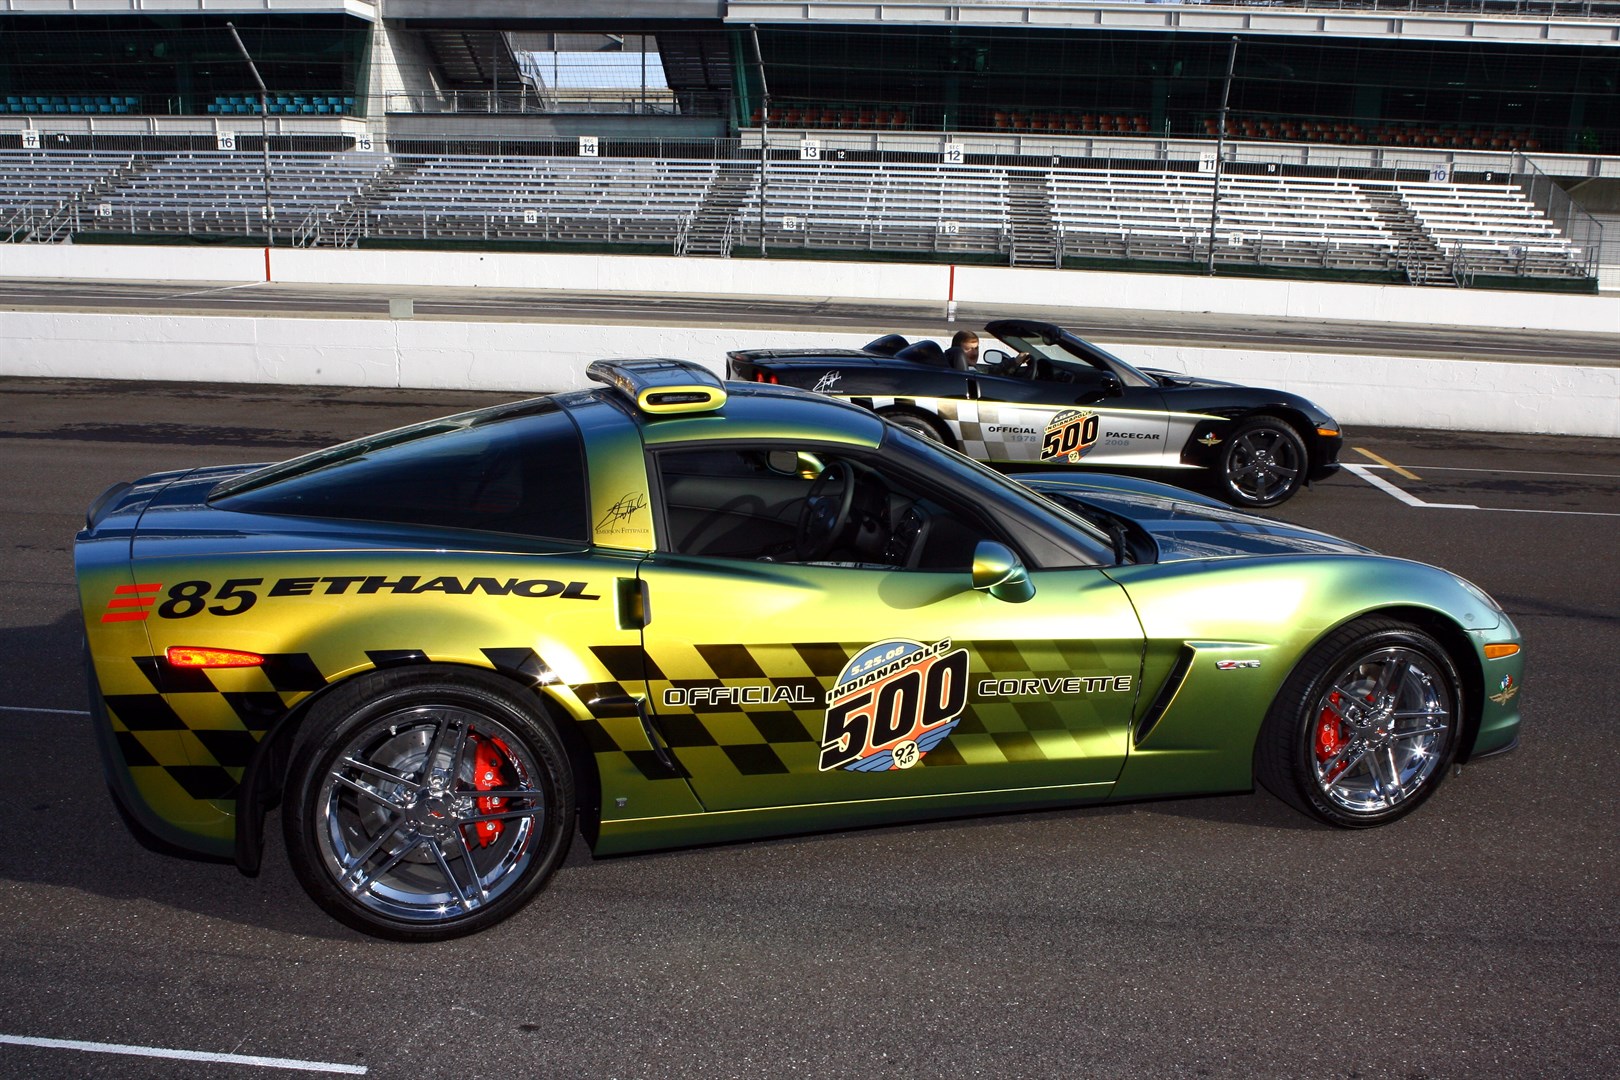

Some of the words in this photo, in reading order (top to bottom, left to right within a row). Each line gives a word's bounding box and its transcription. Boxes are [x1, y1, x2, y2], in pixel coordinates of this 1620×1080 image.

[25, 136, 36, 146] 17
[220, 137, 233, 148] 16
[359, 139, 371, 150] 15
[583, 143, 595, 154] 14
[804, 146, 817, 158] 13
[837, 151, 845, 159] 12
[948, 150, 960, 161] 12
[1204, 160, 1214, 170] 11
[1433, 170, 1446, 181] 10
[948, 225, 957, 233] 12
[1232, 236, 1240, 244] 11
[988, 426, 1037, 434] OFFICIAL
[1040, 414, 1099, 461] 500
[1105, 432, 1160, 440] PACECAR
[1011, 435, 1036, 443] 1978
[267, 575, 601, 601] ETHANOL
[851, 645, 905, 676] 5.25.08
[826, 638, 951, 703] INDIANAPOLIS
[663, 685, 815, 706] OFFICIAL
[819, 648, 969, 771] 500
[978, 675, 1132, 697] CORVETTE
[894, 743, 915, 761] 92
[900, 755, 914, 766] ND
